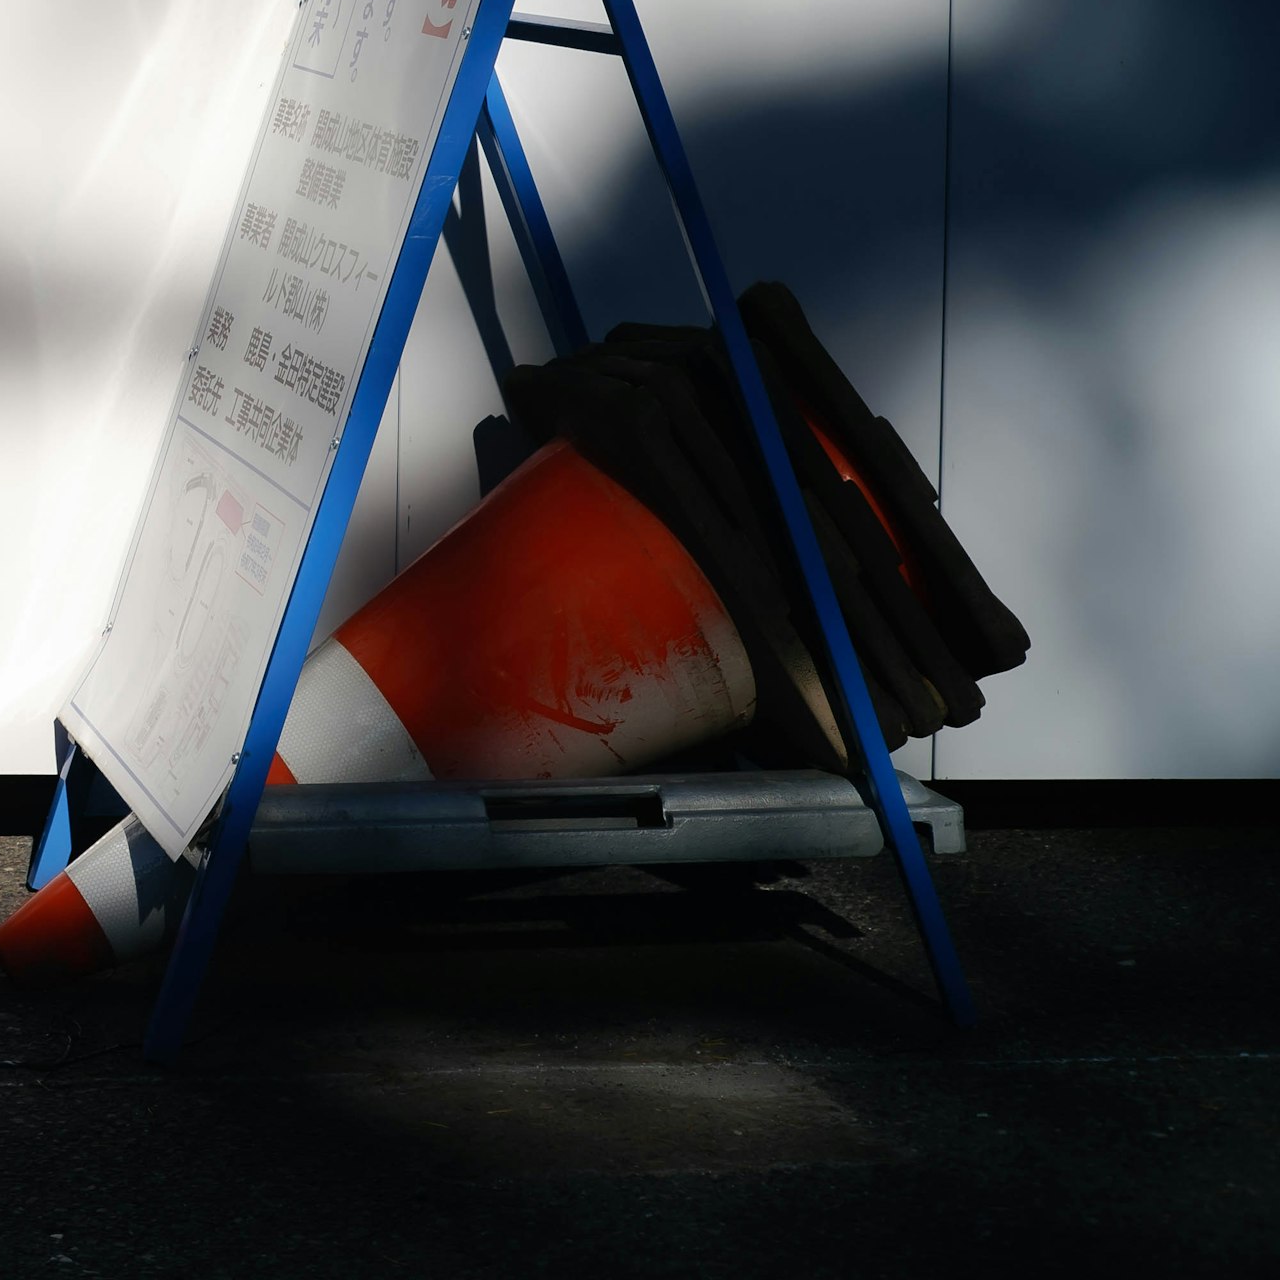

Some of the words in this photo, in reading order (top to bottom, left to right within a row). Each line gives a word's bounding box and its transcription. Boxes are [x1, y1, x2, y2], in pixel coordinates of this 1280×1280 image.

[272, 98, 311, 143] 事業名称
[310, 109, 420, 181] 開成山地区体育施設
[295, 157, 347, 210] 整備事業
[239, 203, 278, 252] 事業者
[277, 217, 379, 291] 開成山クロスフィー
[206, 305, 235, 351] 業務
[188, 365, 225, 417] 委託先
[225, 386, 304, 467] 工事共同企業体
